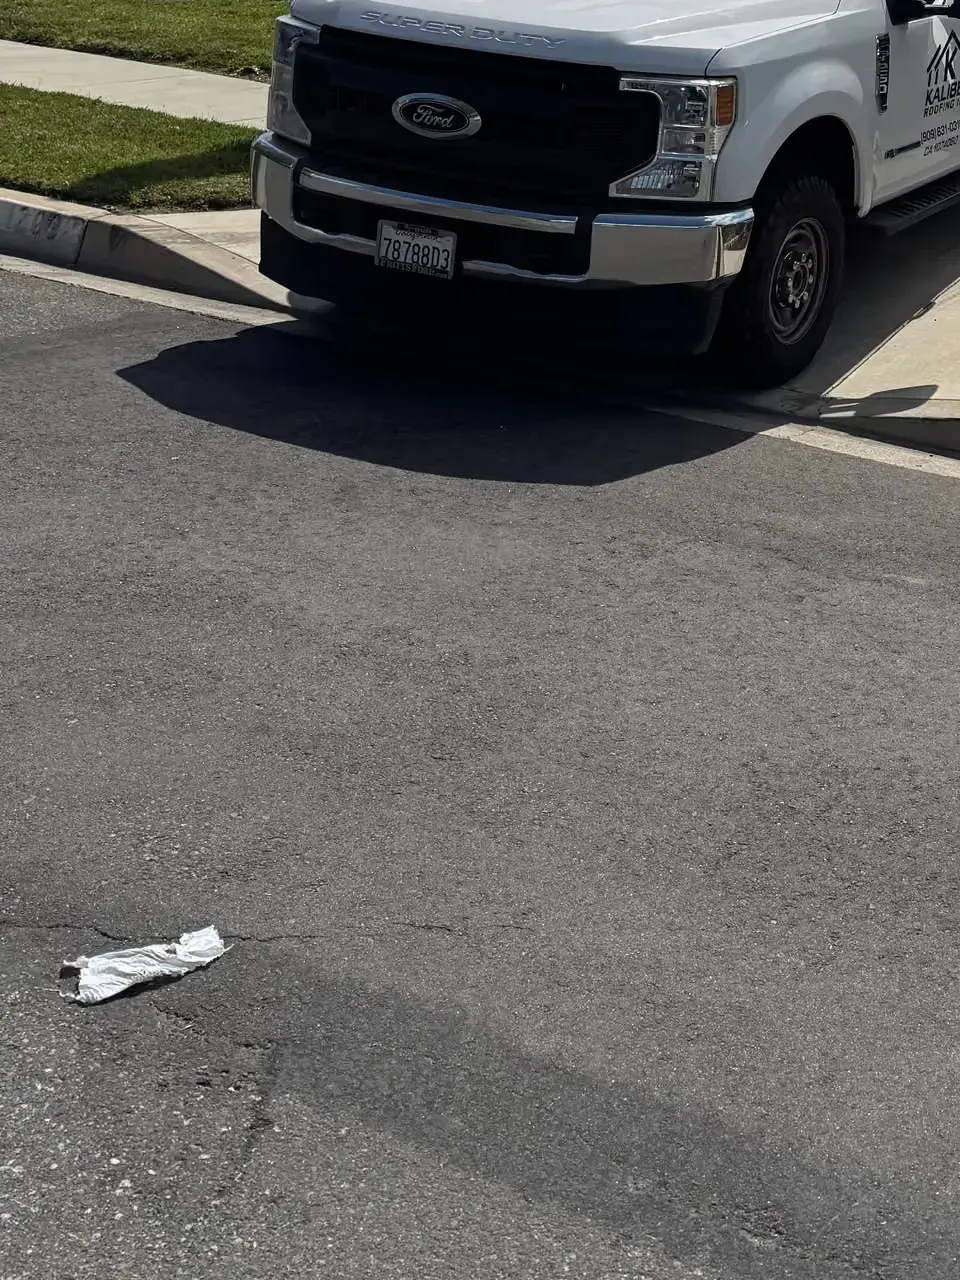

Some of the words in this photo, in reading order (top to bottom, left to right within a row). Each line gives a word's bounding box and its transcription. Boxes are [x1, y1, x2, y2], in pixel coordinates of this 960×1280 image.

[360, 10, 466, 38] SUPER
[469, 27, 567, 50] DUTY
[412, 102, 454, 130] Ford
[923, 100, 955, 118] ROOFING
[383, 237, 450, 269] 78788D3
